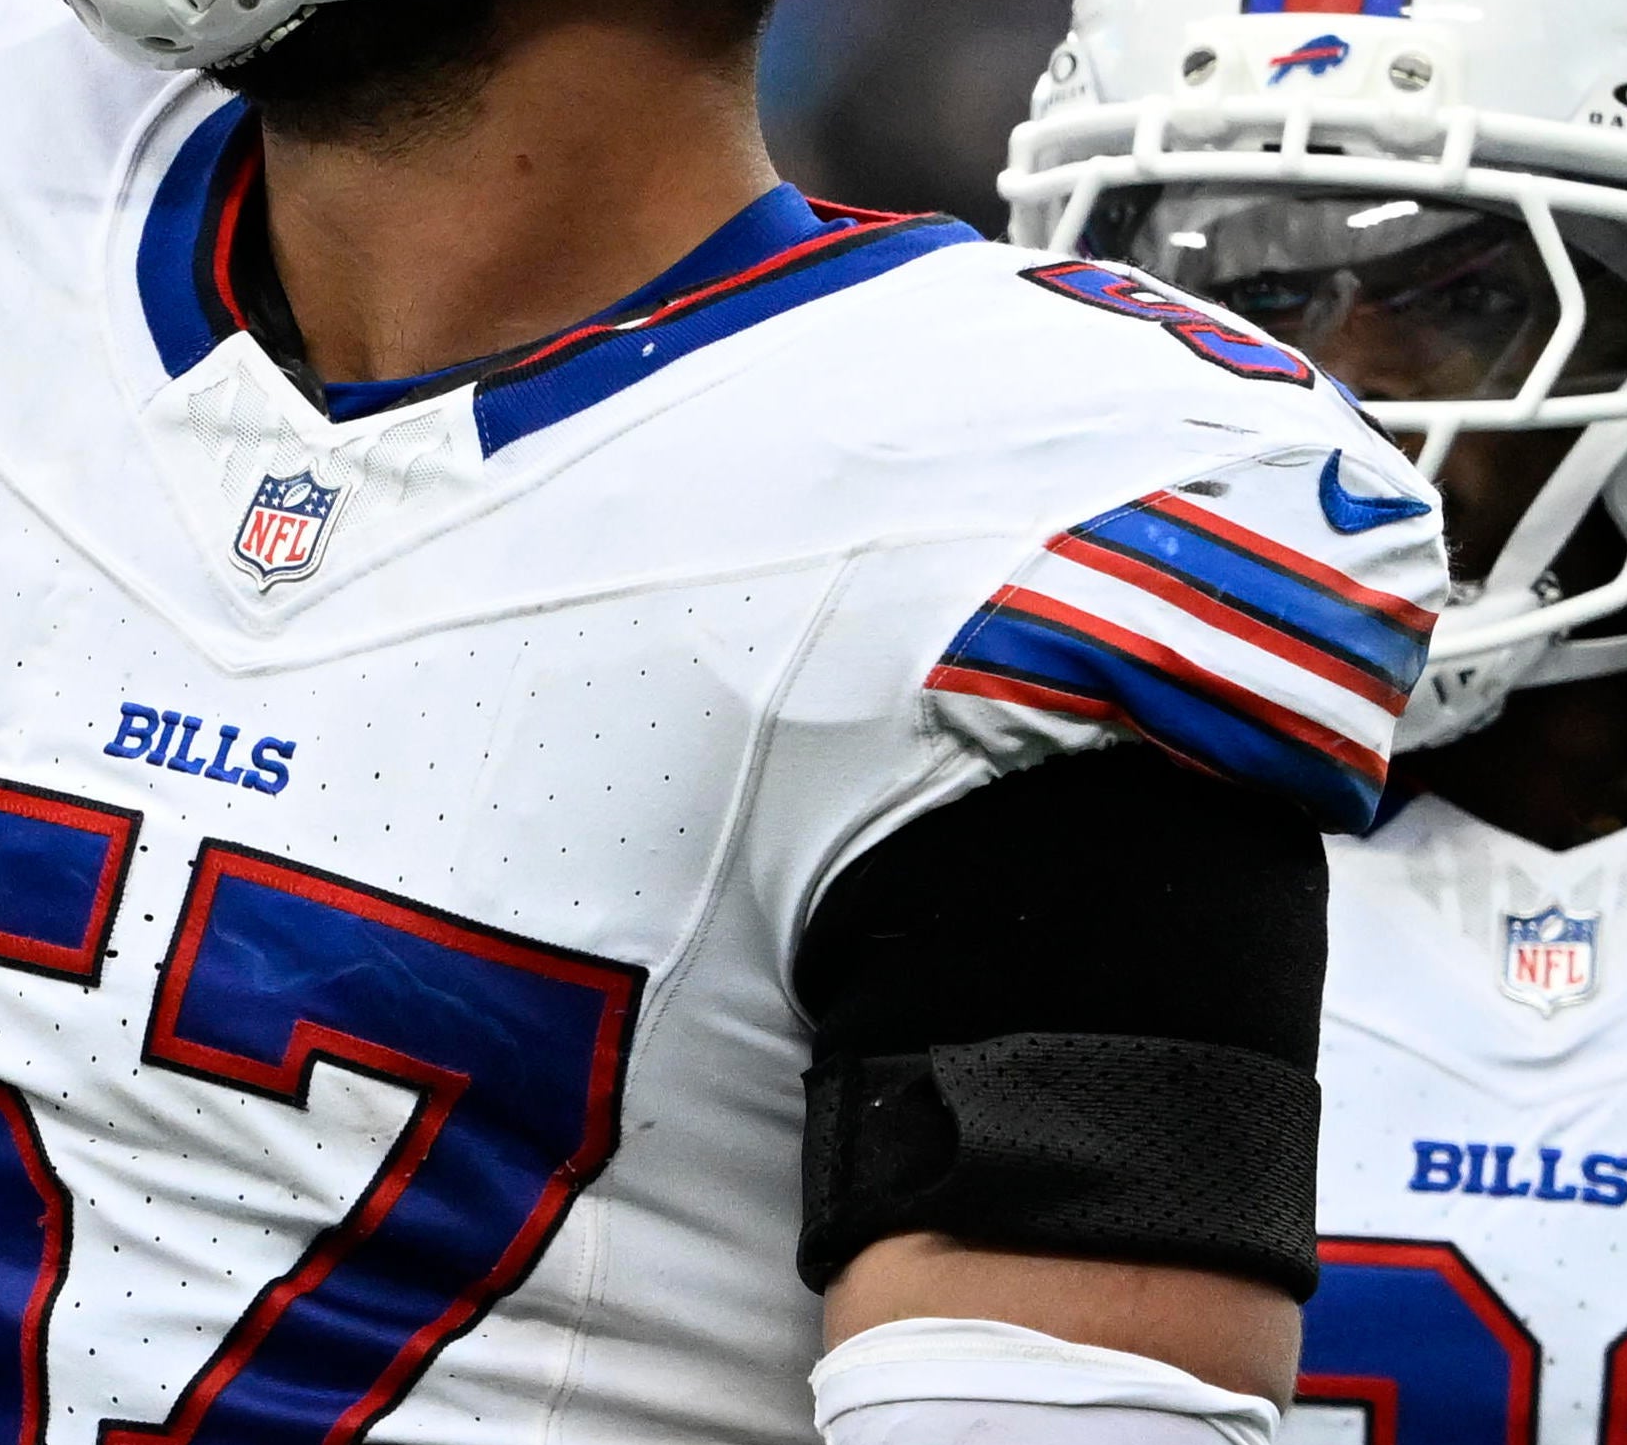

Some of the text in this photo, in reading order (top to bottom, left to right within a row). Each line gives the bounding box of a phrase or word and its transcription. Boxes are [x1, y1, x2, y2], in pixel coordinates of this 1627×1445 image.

[242, 510, 309, 565] NFL
[103, 701, 297, 796] BILLS
[1516, 948, 1584, 989] NFL
